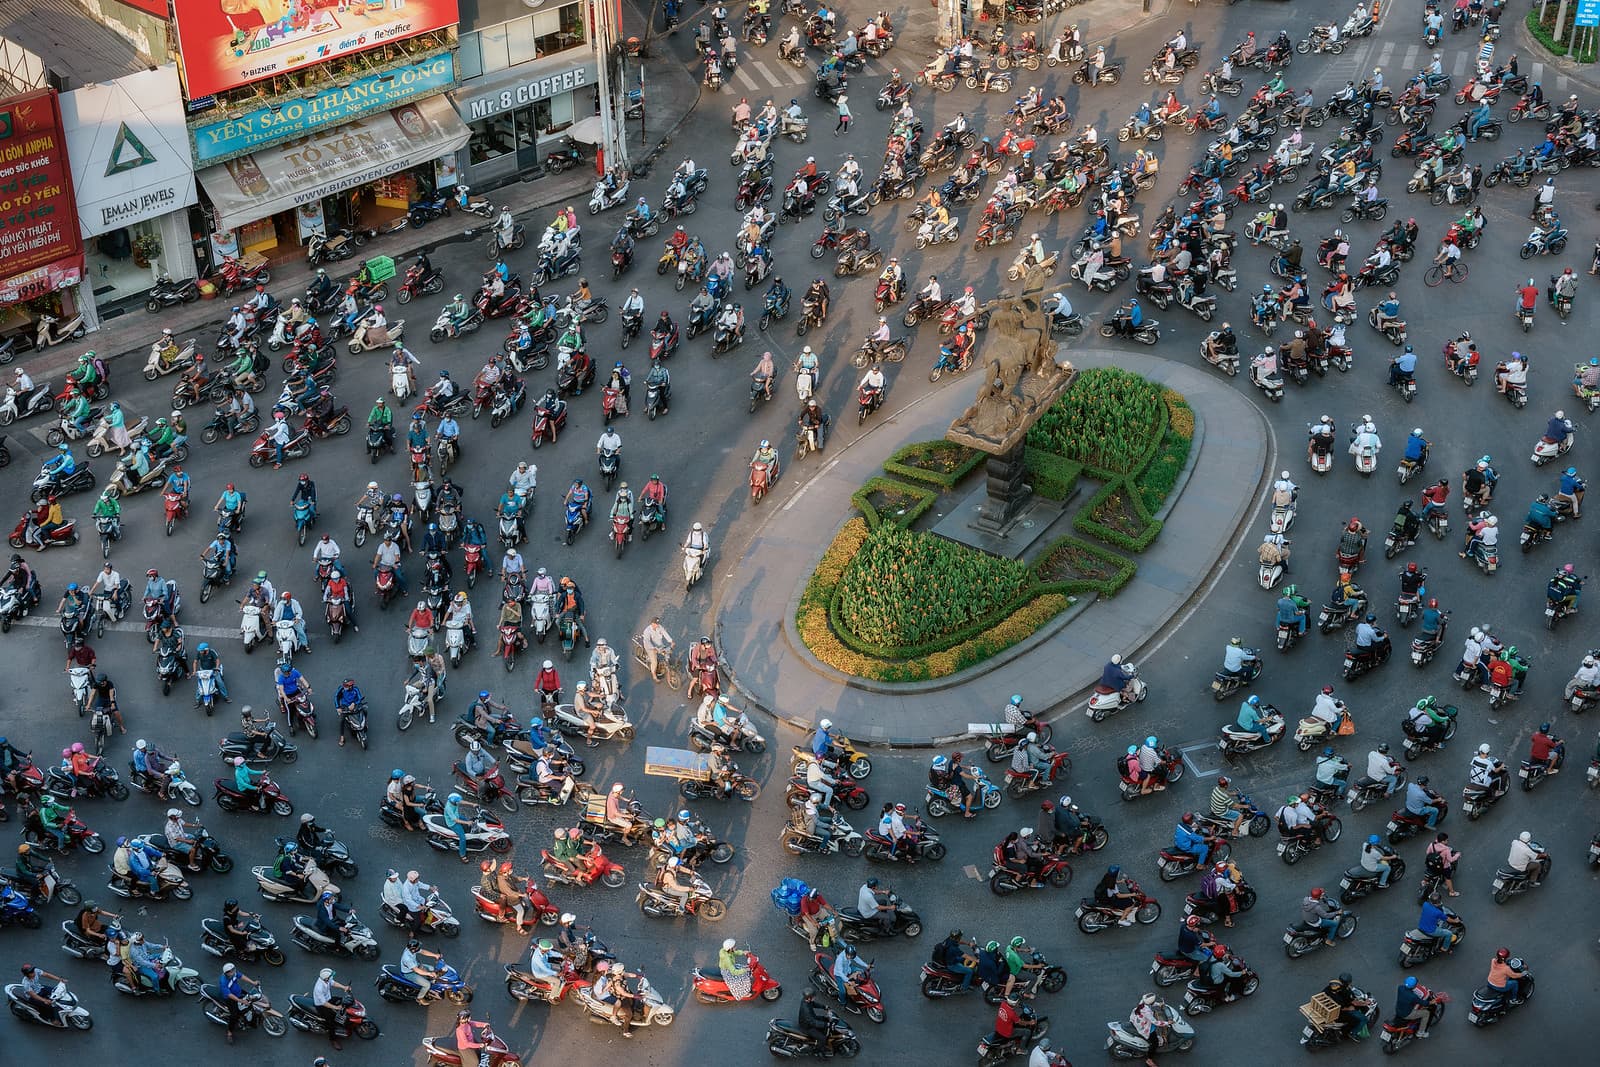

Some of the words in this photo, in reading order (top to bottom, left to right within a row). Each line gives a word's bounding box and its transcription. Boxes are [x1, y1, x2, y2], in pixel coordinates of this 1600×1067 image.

[250, 37, 270, 51] 2018
[249, 63, 277, 76] BIZNER
[516, 68, 585, 103] COFFEE
[25, 136, 54, 155] ANPHA
[294, 159, 410, 204] WWW.BIATOYEN.COM
[140, 188, 175, 210] JEWELS
